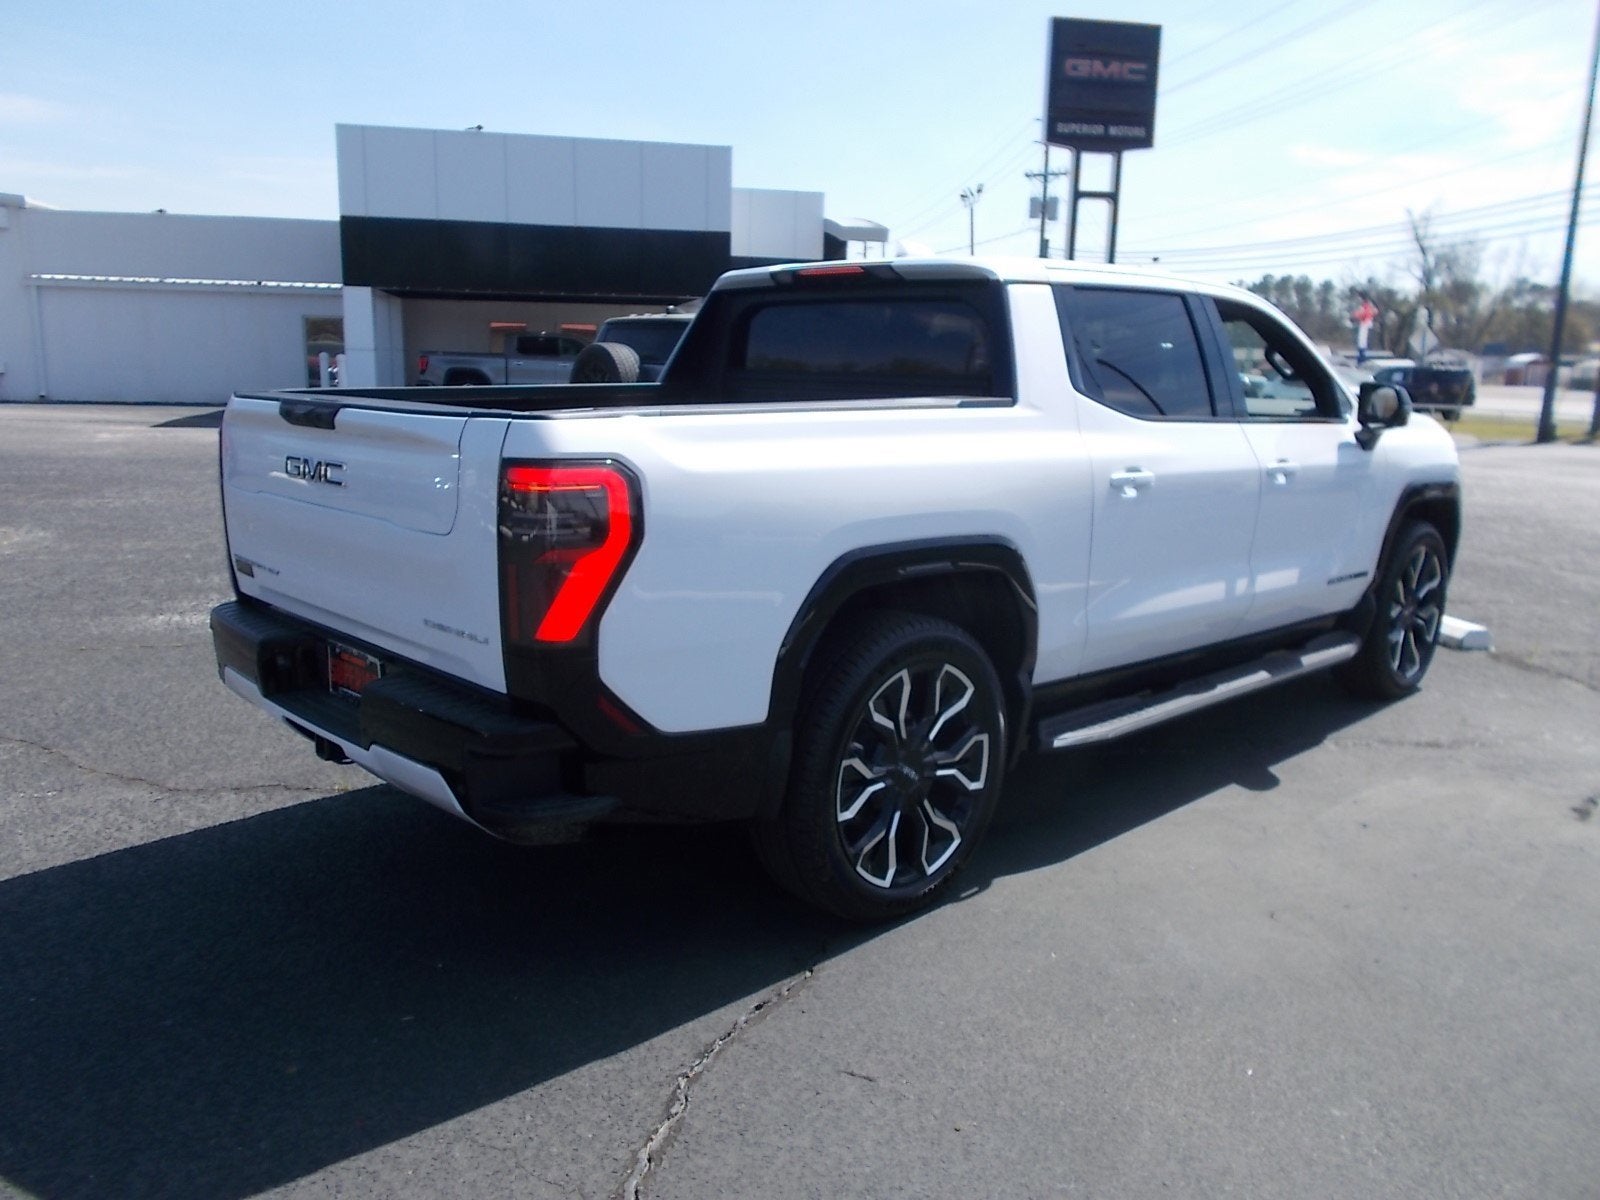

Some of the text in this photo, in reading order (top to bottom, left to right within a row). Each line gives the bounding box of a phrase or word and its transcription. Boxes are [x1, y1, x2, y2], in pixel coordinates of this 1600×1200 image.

[1064, 58, 1148, 81] GMC
[1056, 122, 1105, 136] SUPERIOR
[285, 455, 346, 487] GMC
